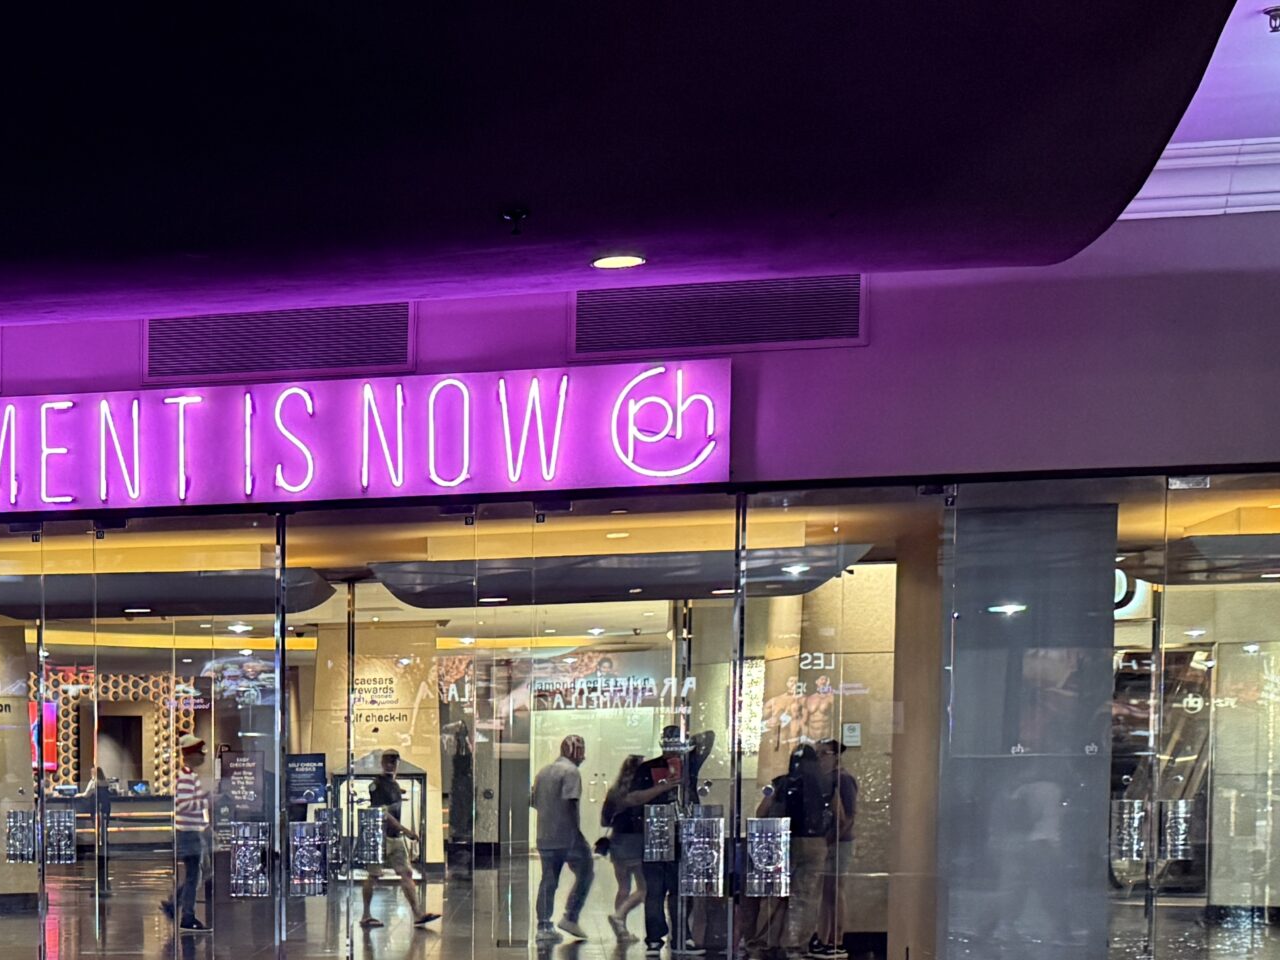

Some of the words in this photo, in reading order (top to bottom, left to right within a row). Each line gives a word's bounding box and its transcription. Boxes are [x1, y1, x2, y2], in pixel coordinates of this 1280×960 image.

[245, 386, 315, 496] IS
[361, 373, 568, 489] NOW
[354, 677, 394, 685] caesars
[354, 685, 394, 694] rewards
[344, 713, 363, 722] slf
[365, 712, 408, 722] check-in
